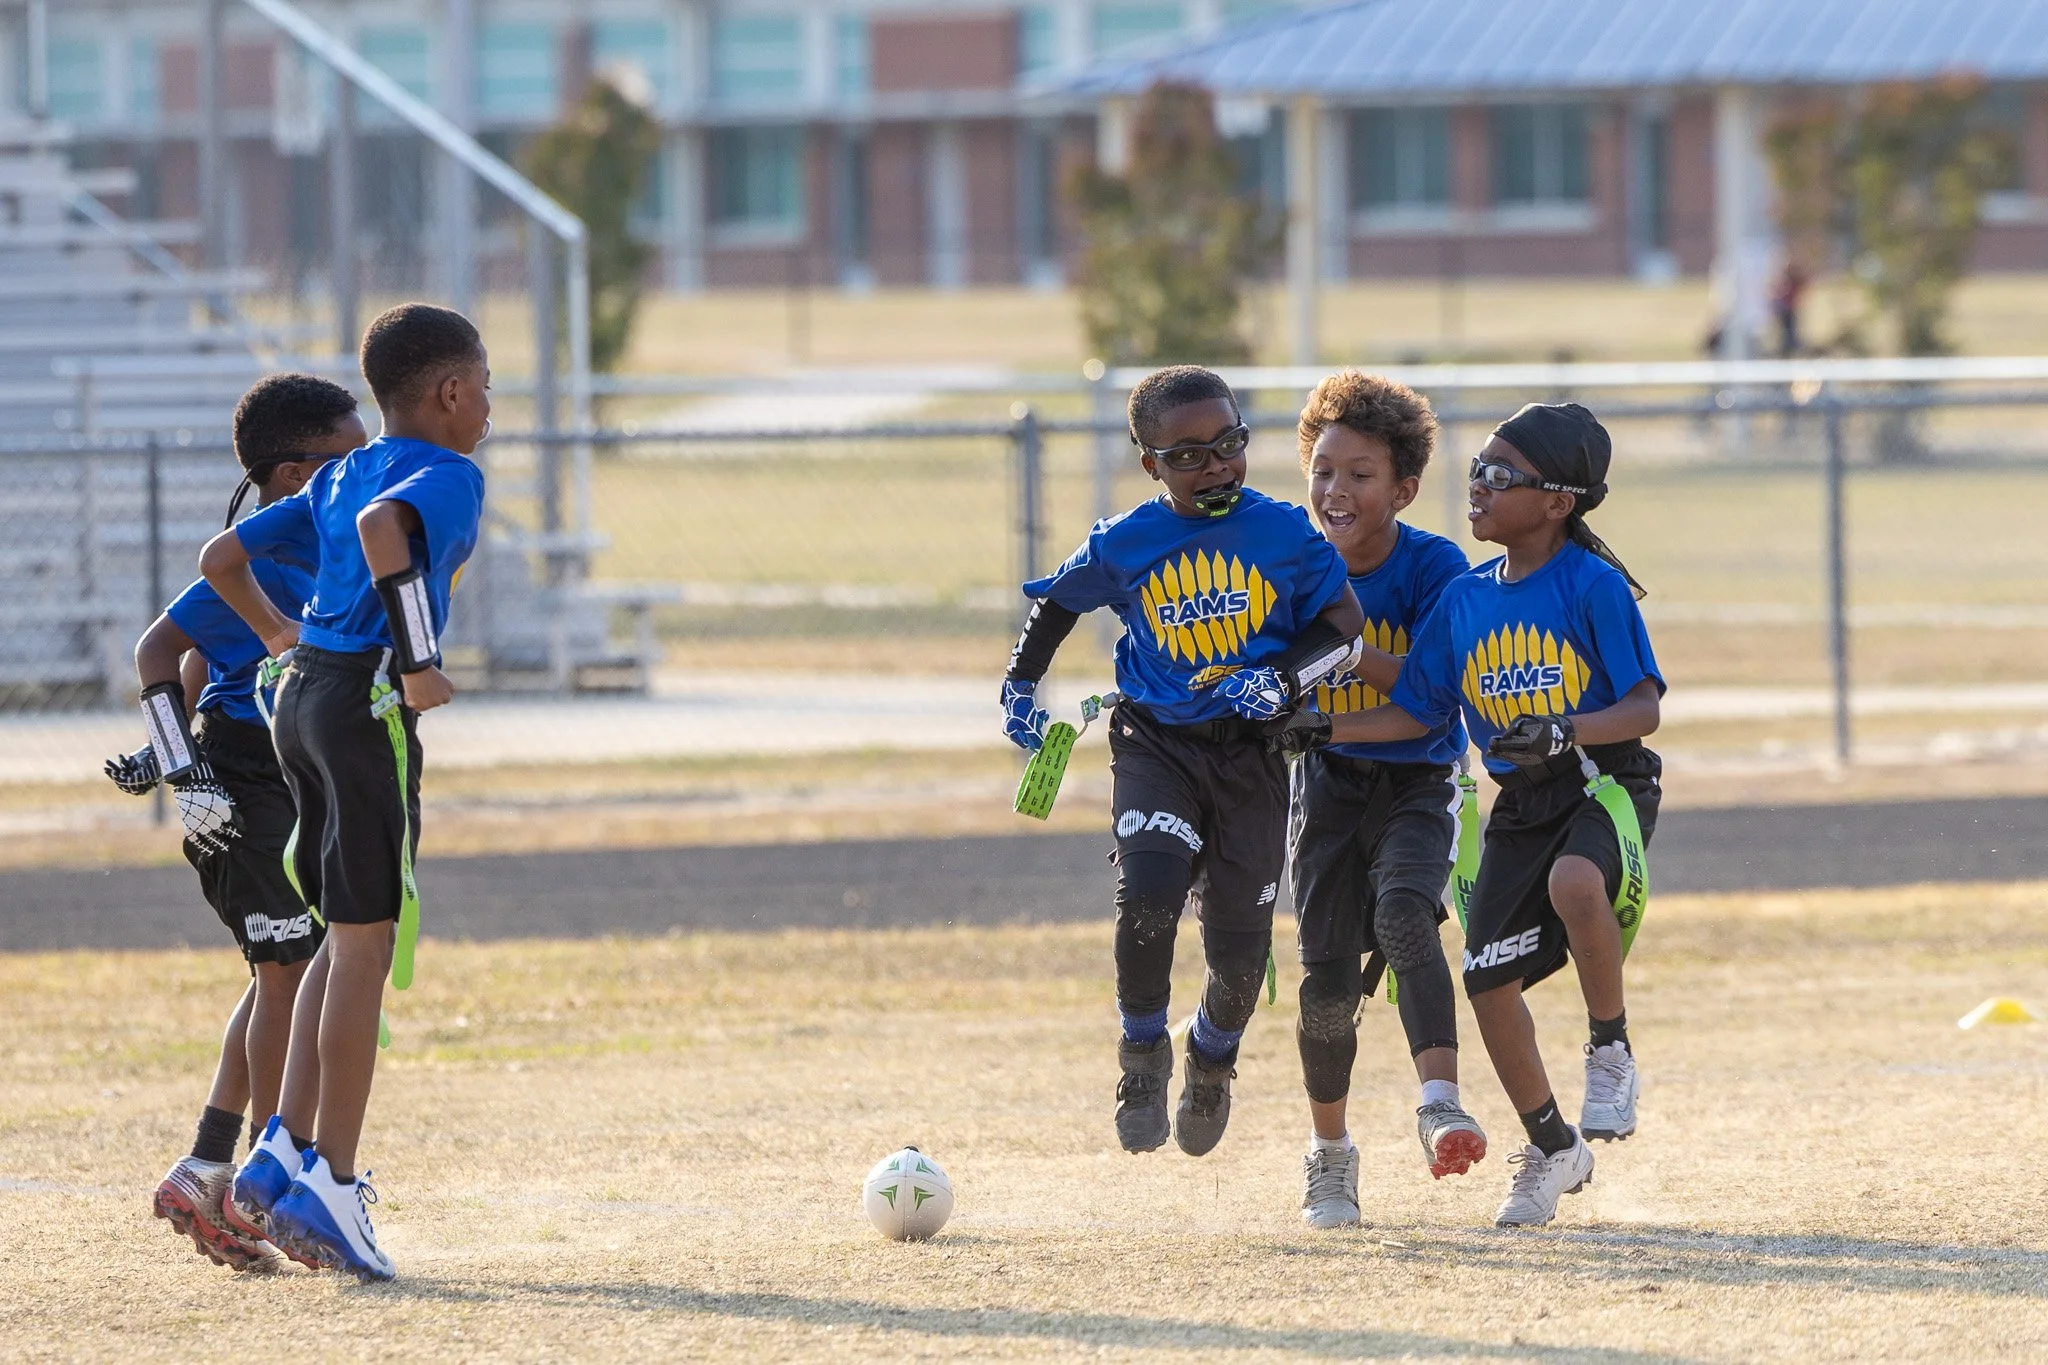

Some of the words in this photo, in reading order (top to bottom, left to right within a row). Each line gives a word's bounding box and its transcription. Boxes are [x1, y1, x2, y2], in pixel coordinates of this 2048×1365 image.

[1543, 482, 1560, 491] REC
[1561, 485, 1587, 494] SPECS
[1157, 589, 1250, 626] RAMS
[1479, 664, 1563, 697] RAMS
[1145, 811, 1204, 853] RISE
[1623, 835, 1643, 906] RISE
[1468, 925, 1541, 971] RISE
